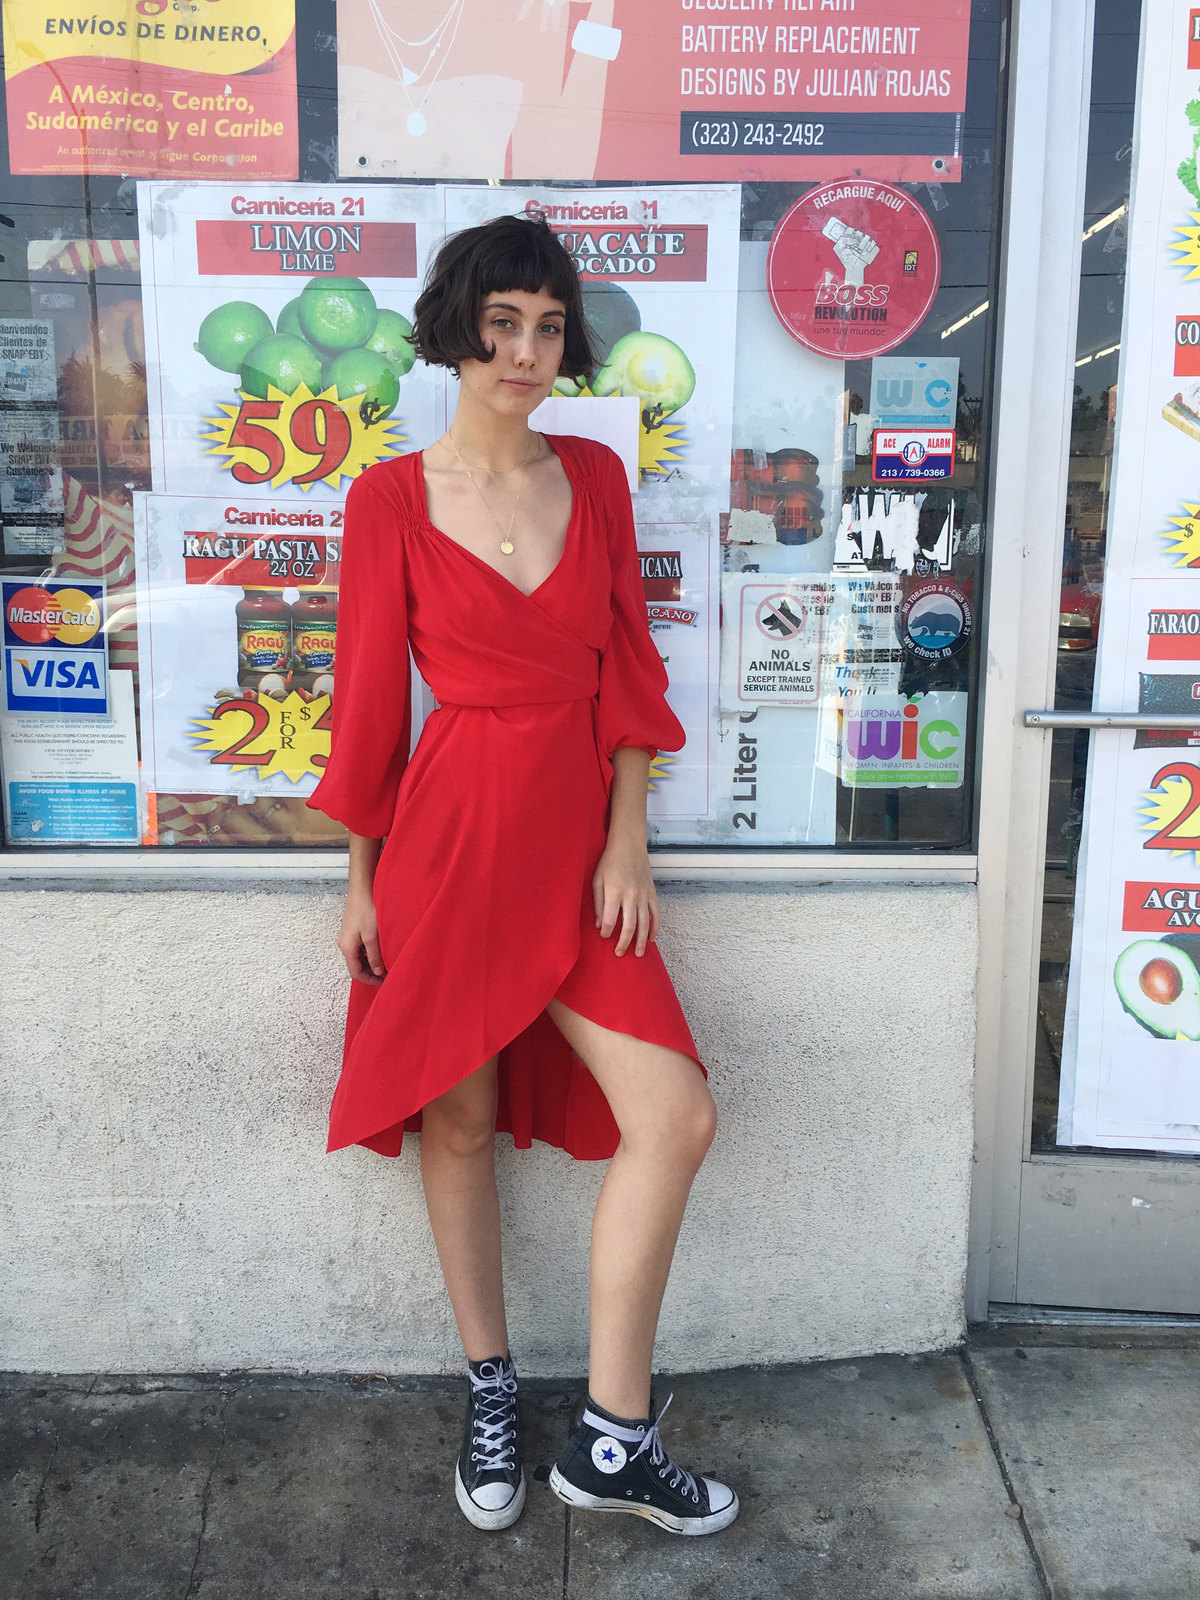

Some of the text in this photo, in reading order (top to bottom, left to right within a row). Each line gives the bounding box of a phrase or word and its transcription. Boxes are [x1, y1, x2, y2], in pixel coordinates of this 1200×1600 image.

[45, 15, 127, 37] ENVÍOS
[136, 22, 165, 39] DE
[681, 25, 920, 55] BATTERY REPLACEMENT
[680, 67, 951, 98] DESIGNS BY JULIAN ROJAS
[48, 84, 255, 115] A México, Centro,
[26, 110, 284, 141] Sudamérica y el Caribe
[691, 121, 824, 148] (323) 243-2492
[57, 145, 69, 155] An
[231, 195, 365, 216] Carnicería 21
[812, 185, 906, 213] RECARGUE AQUÍ
[525, 199, 628, 221] Carnicería
[250, 222, 363, 254] LIMON
[557, 230, 686, 256] UACATE
[280, 252, 336, 272] LIME
[815, 282, 891, 307] BOSS
[814, 306, 887, 321] REVOLUTION
[813, 326, 830, 335] une
[850, 326, 886, 336] mundos
[1176, 320, 1200, 346] CO
[883, 438, 951, 448] ACE ALARM
[881, 469, 898, 477] 213
[905, 469, 945, 477] 739-0366
[224, 506, 324, 527] Carnicería
[252, 538, 322, 563] PASTA
[269, 560, 315, 578] 24 OZ
[639, 556, 682, 578] ICANA
[908, 584, 937, 603] TOBACCO
[944, 586, 965, 603] E-CIGS
[9, 607, 98, 626] MasterCard
[647, 608, 692, 622] ICANO
[901, 603, 911, 613] NO
[961, 602, 972, 626] UNDER
[962, 626, 971, 636] 21
[1147, 611, 1200, 635] FARAO
[771, 649, 790, 660] NO
[914, 647, 941, 659] check
[942, 647, 952, 657] ID
[14, 659, 100, 689] VISA
[749, 660, 811, 672] ANIMALS
[743, 684, 777, 692] SERVICE
[747, 675, 812, 684] EXCEPT TRAINED
[847, 709, 902, 718] CALIFORNIA
[210, 699, 277, 766] 2
[279, 711, 296, 750] FOR
[732, 732, 758, 801] Liter
[732, 812, 757, 830] 2
